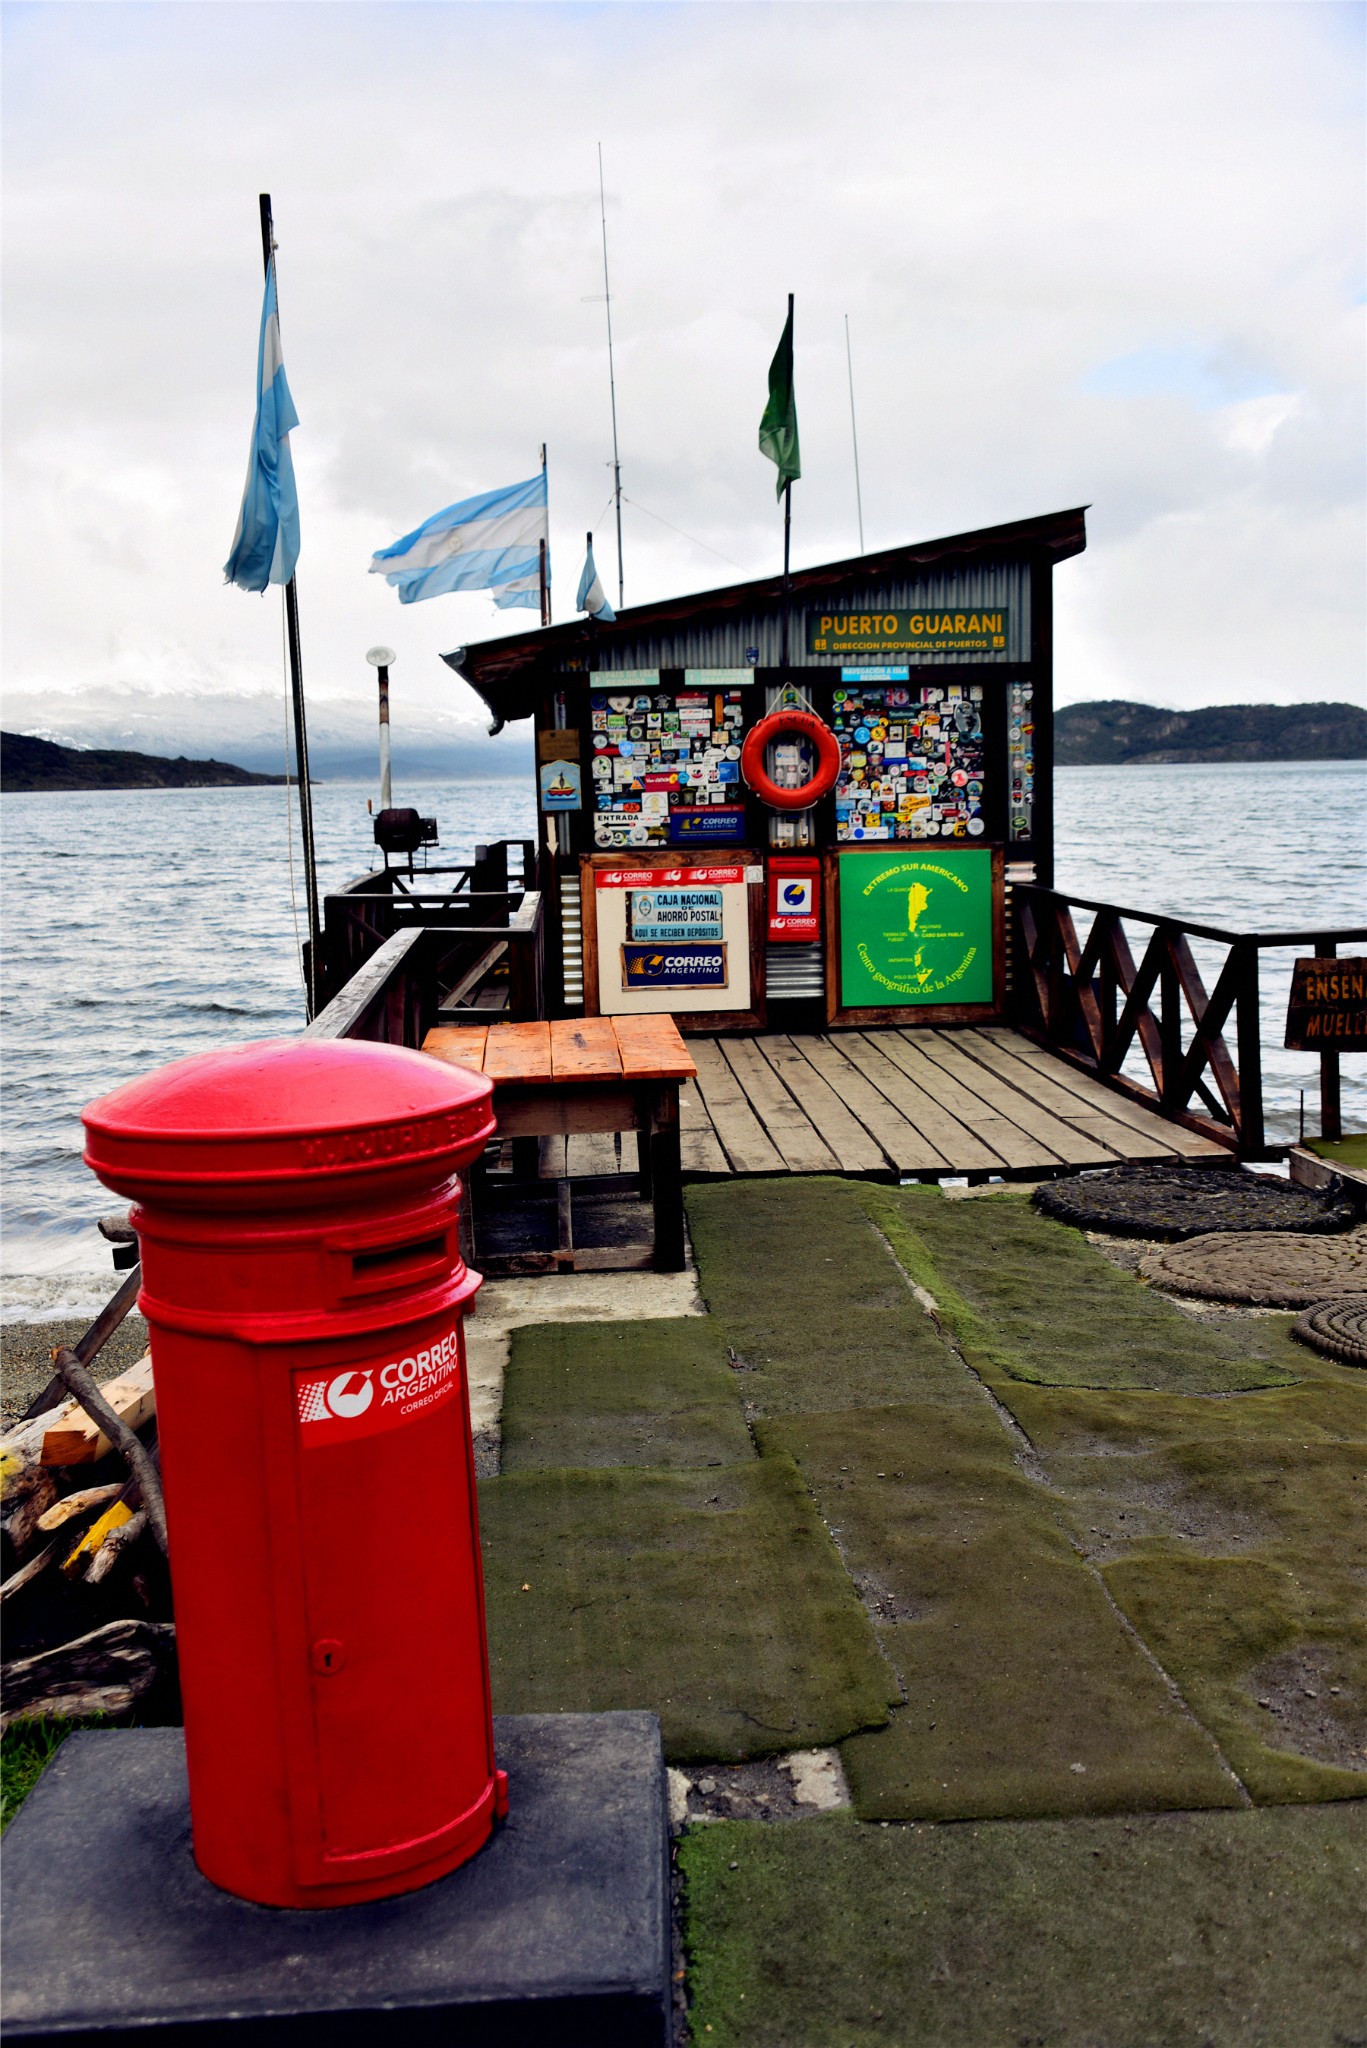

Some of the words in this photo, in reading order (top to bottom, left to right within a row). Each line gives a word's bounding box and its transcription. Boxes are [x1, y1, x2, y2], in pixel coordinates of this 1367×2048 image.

[820, 615, 898, 635] PUERTO
[909, 614, 1002, 634] GUARANI
[832, 642, 880, 650] DIRECCION
[881, 641, 934, 649] PROVINCIAL
[948, 640, 987, 648] PUERTOS
[703, 817, 737, 825] CORREO
[863, 866, 900, 896] EXTREMO
[901, 863, 919, 871] SUR
[920, 863, 969, 893] AMERICANO
[657, 895, 678, 906] CAJA
[681, 894, 719, 905] NACIONAL
[657, 911, 688, 922] AHORRO
[690, 911, 719, 922] POSTAL
[650, 928, 658, 937] SE
[660, 928, 685, 937] RECIBEN
[665, 956, 722, 967] CORREO
[857, 943, 876, 973] Centro
[872, 971, 920, 994] geográfico
[922, 983, 934, 993] de
[934, 980, 945, 990] la
[945, 947, 977, 985] Argentina
[1306, 975, 1367, 1000] ENSEN
[380, 1331, 457, 1388] CORREO
[381, 1355, 457, 1406] ARGENTINO
[400, 1394, 433, 1415] CORREO
[434, 1381, 454, 1399] OFICIAL
